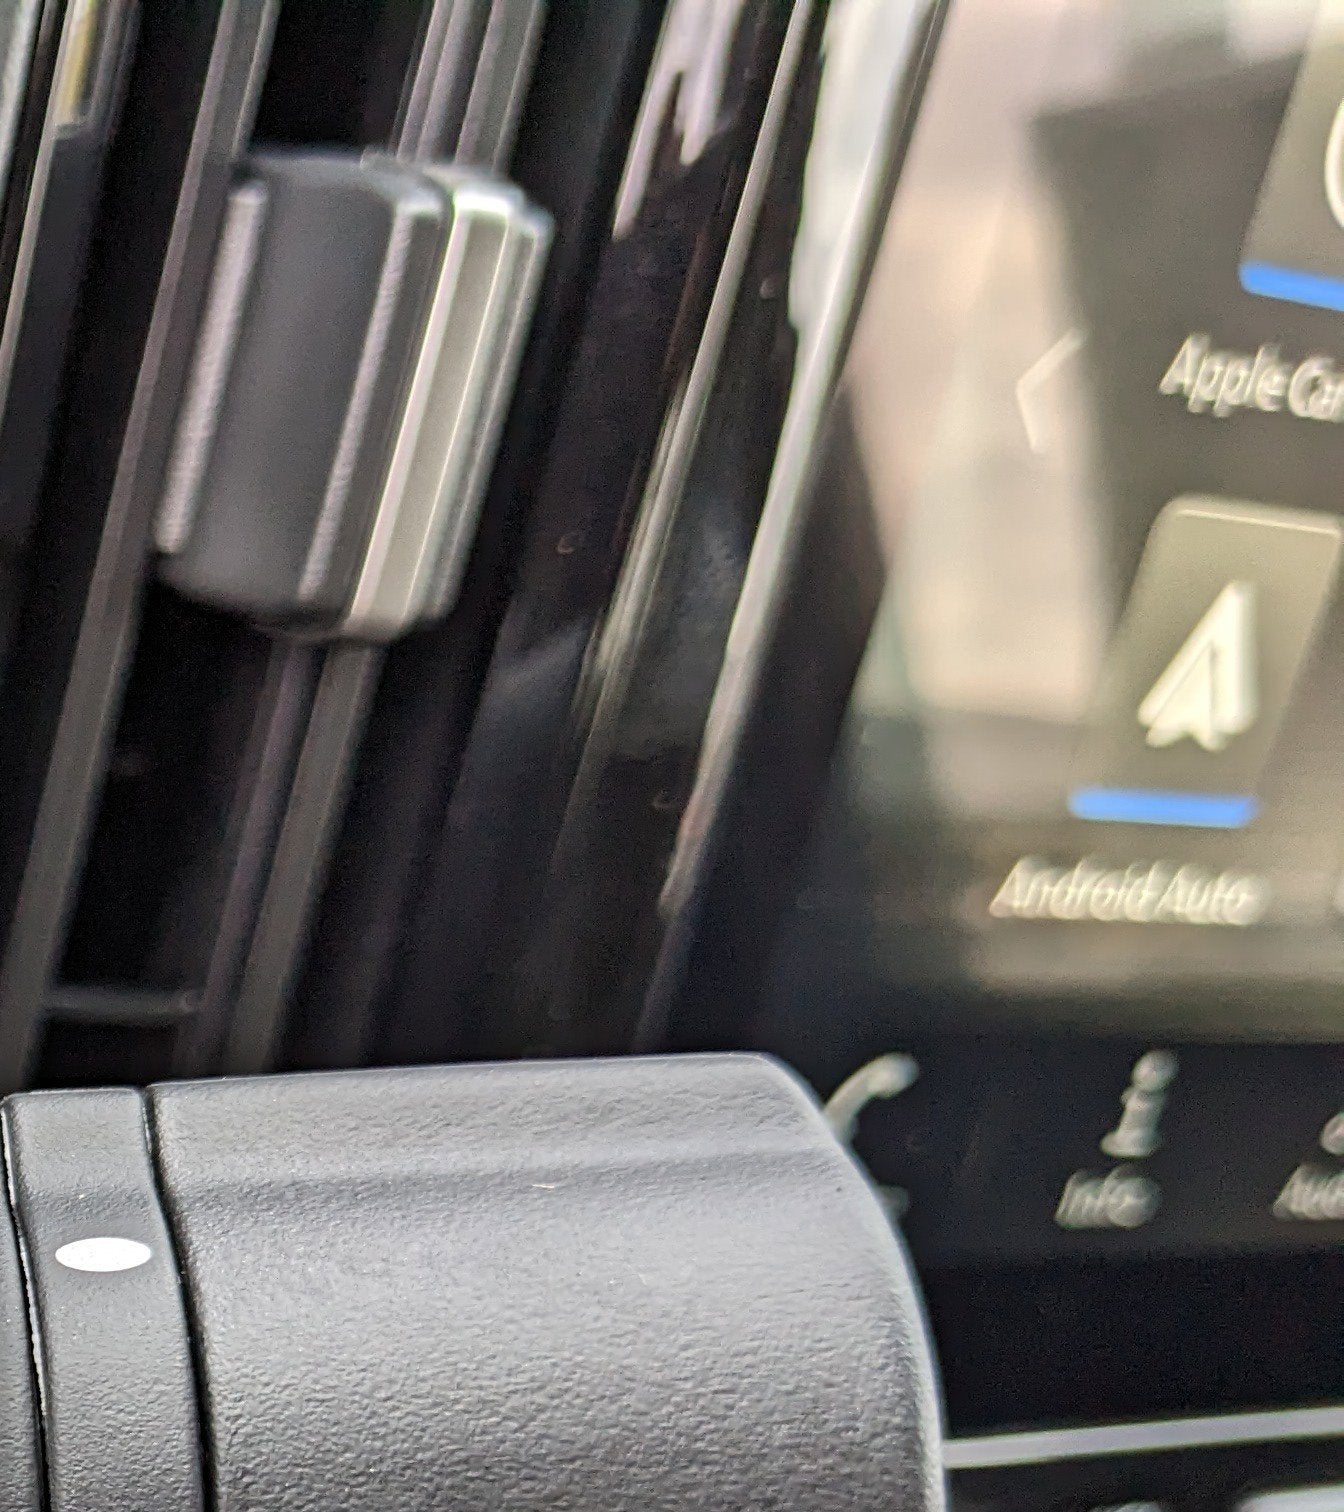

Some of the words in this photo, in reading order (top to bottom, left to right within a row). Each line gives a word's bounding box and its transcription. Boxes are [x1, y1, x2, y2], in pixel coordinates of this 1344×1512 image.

[1159, 333, 1292, 417] Apple
[989, 855, 1164, 921] Android
[1154, 862, 1268, 926] Auto
